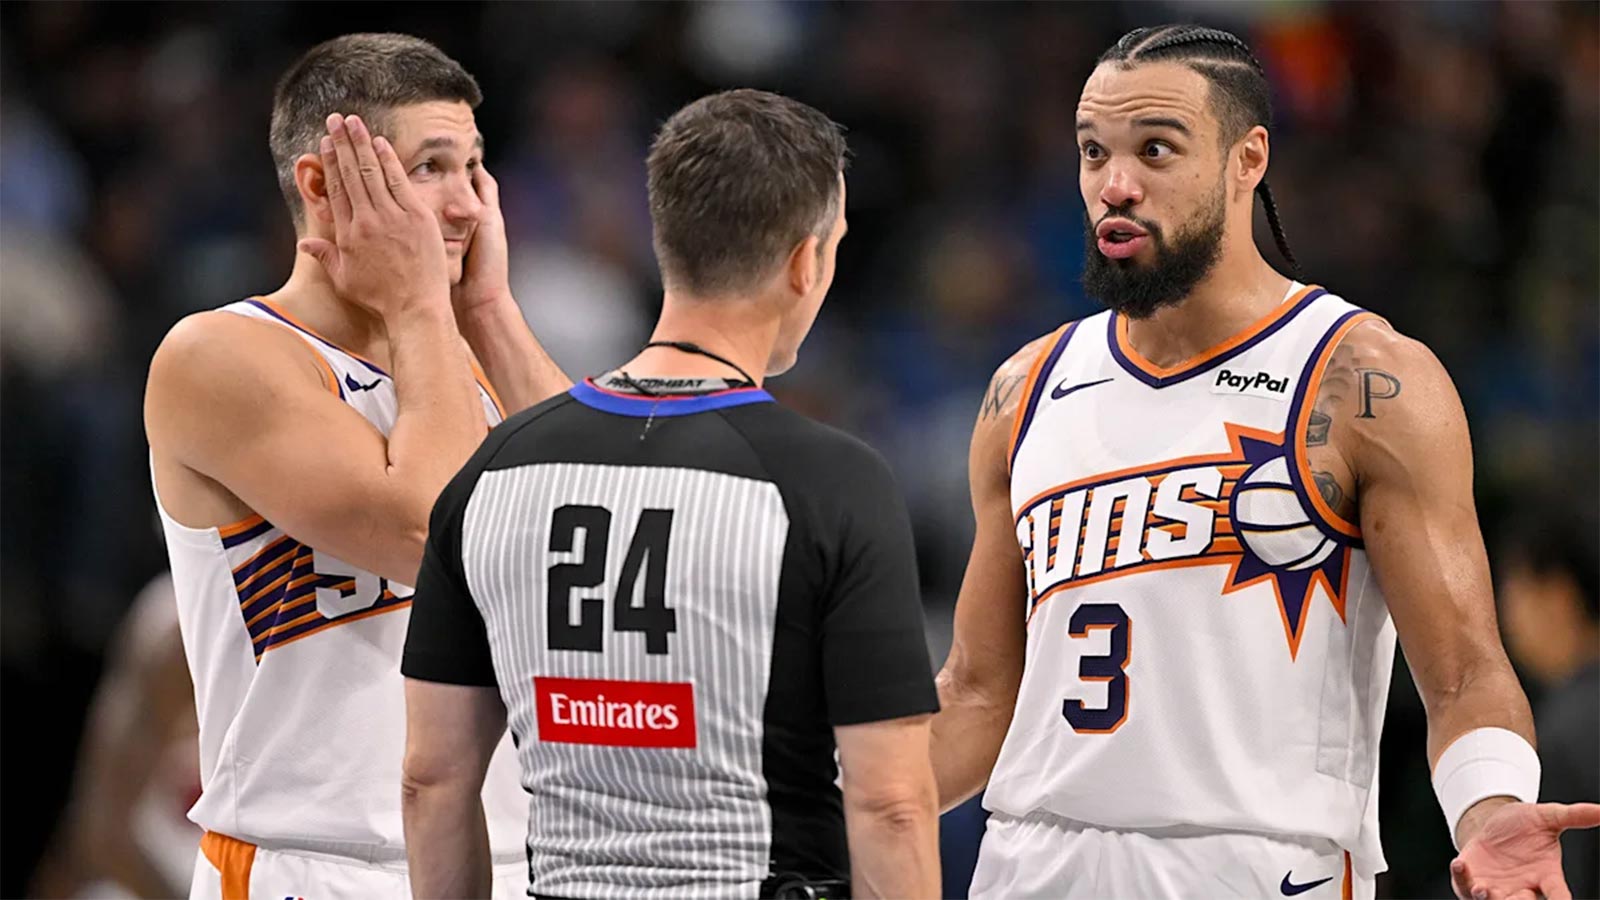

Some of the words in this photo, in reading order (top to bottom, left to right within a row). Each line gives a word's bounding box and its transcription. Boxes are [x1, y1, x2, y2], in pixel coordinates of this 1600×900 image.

[1215, 369, 1289, 393] PayPal
[1354, 368, 1401, 418] P
[547, 504, 676, 655] 24
[1062, 603, 1132, 734] 3
[550, 693, 679, 729] Emirates
